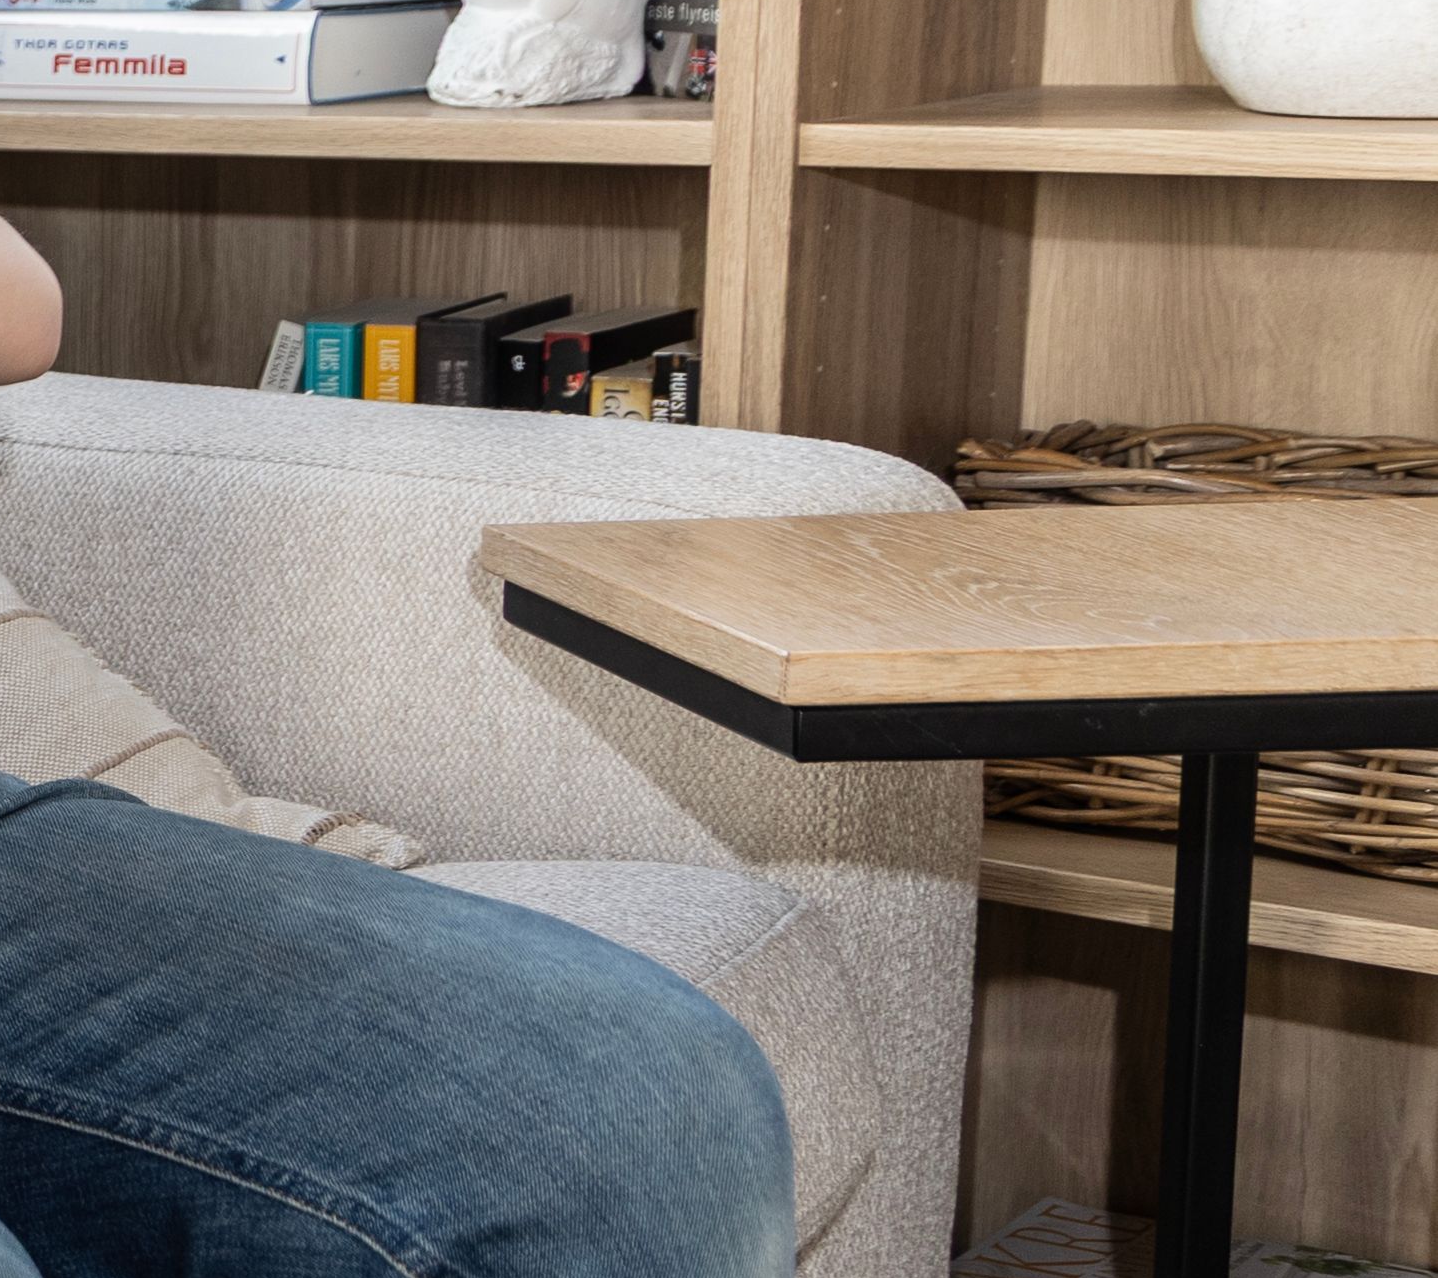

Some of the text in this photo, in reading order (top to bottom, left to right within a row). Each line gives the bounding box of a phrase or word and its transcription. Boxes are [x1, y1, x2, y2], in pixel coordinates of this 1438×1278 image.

[14, 38, 130, 51] THOR GOTAAS
[52, 54, 188, 77] Femmila
[267, 334, 292, 386] ERIKSON
[278, 338, 302, 389] THOMAS
[318, 338, 341, 371] LARS
[378, 339, 400, 371] LARS
